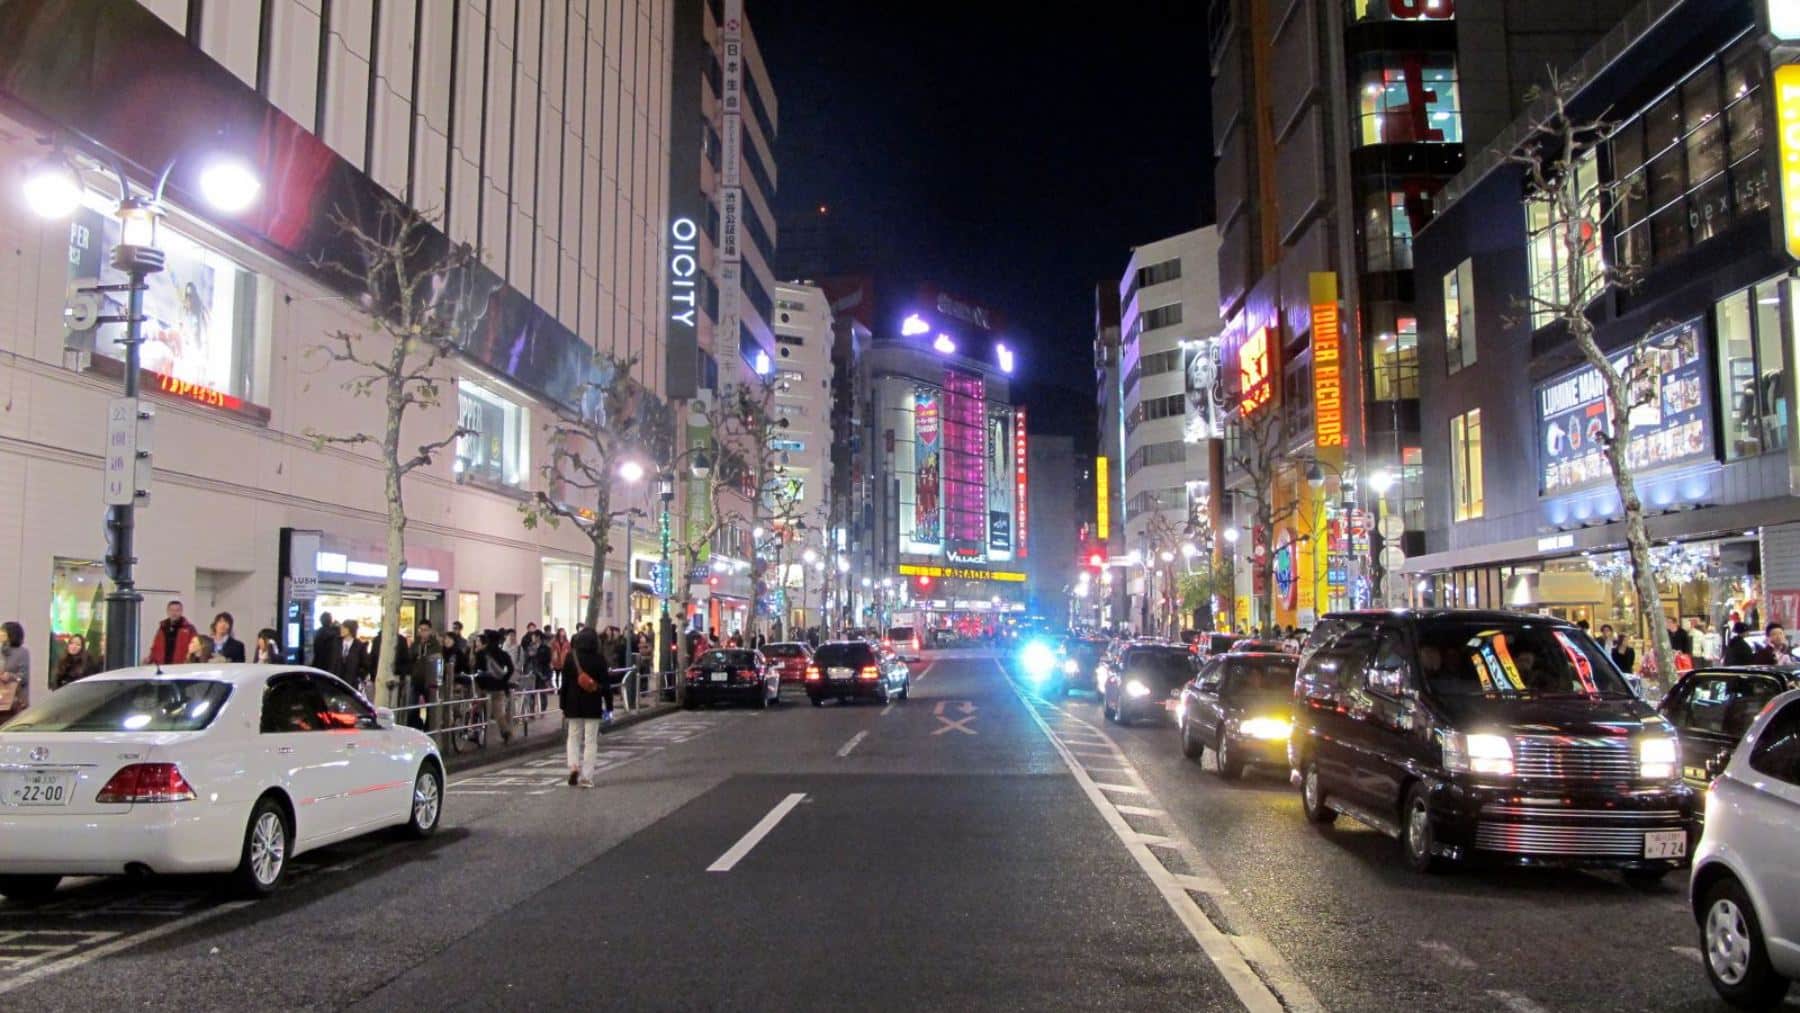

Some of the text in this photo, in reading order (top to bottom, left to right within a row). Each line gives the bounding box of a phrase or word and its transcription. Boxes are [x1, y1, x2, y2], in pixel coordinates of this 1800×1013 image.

[1312, 303, 1342, 447] TOWER RECORDS
[293, 577, 318, 586] LUSH
[22, 785, 63, 801] 22-00
